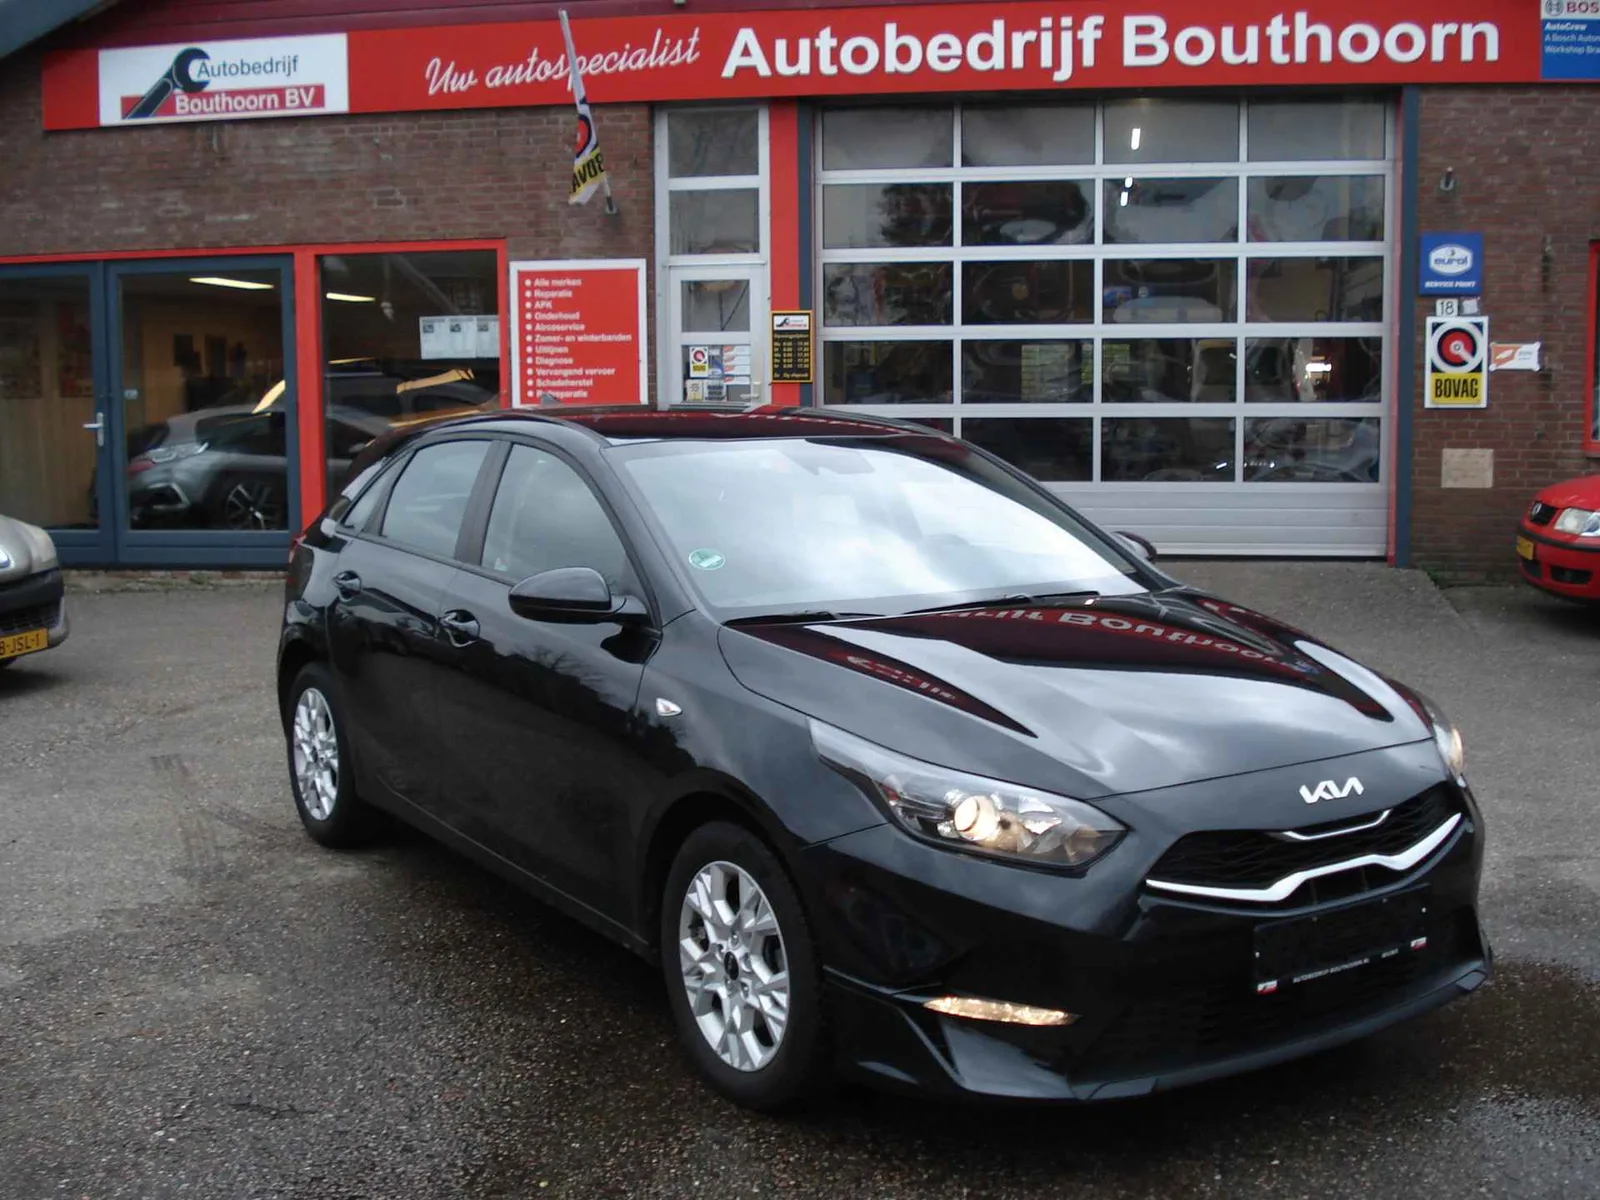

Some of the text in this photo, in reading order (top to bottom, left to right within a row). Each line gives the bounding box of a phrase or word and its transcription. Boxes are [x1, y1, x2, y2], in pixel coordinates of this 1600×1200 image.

[721, 12, 1499, 82] Autobedrijf Bouthoorn
[425, 26, 700, 95] Uw autospecialist
[197, 55, 299, 78] Autobedrijf
[175, 87, 315, 114] Bouthoorn BV
[533, 277, 582, 286] Alle merken
[533, 289, 573, 299] Reparatie
[534, 300, 553, 309] APK
[1440, 301, 1455, 315] 18
[534, 311, 581, 321] Onderhoud
[577, 332, 633, 342] winterbanden
[535, 356, 574, 367] Diagnose
[536, 367, 616, 378] Vervangend vervoer
[536, 378, 594, 388] Schadeherstel
[1435, 378, 1479, 399] BOVAG
[1299, 776, 1364, 804] KIA
